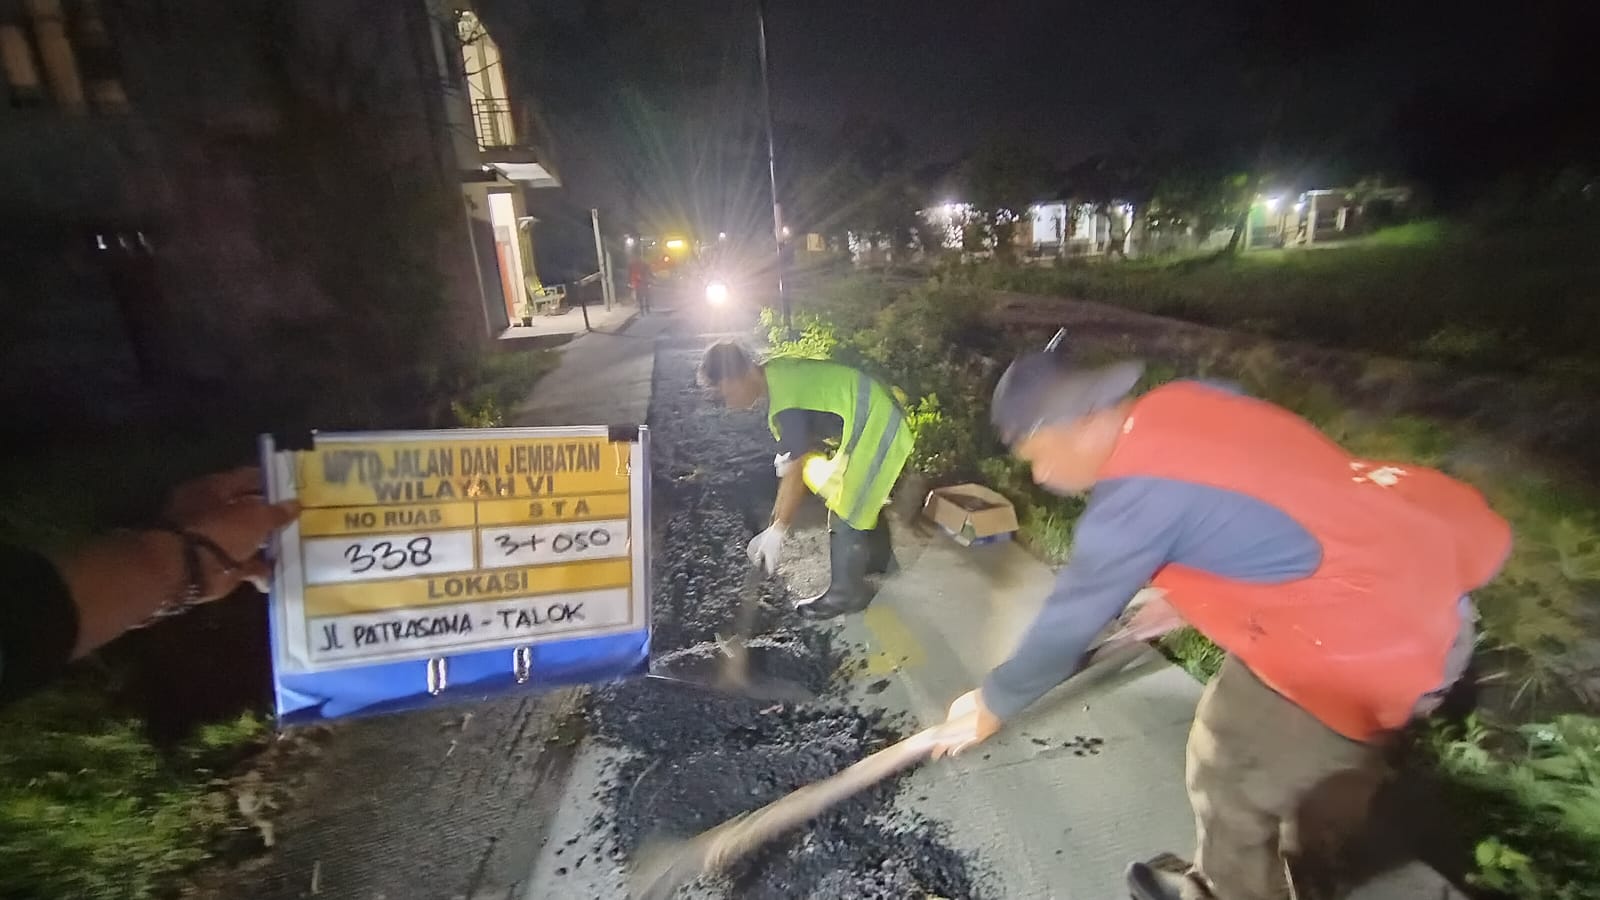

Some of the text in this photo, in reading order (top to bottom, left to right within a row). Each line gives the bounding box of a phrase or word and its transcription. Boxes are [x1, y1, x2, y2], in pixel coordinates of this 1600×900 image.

[387, 447, 453, 478] JALAN
[461, 445, 499, 475] DAN
[505, 442, 600, 474] JEMBATAN
[526, 474, 554, 496] VI
[344, 509, 442, 529] NO RUAS
[343, 536, 433, 573] 338
[427, 571, 528, 599] LOKASI
[496, 602, 586, 629] TALOK
